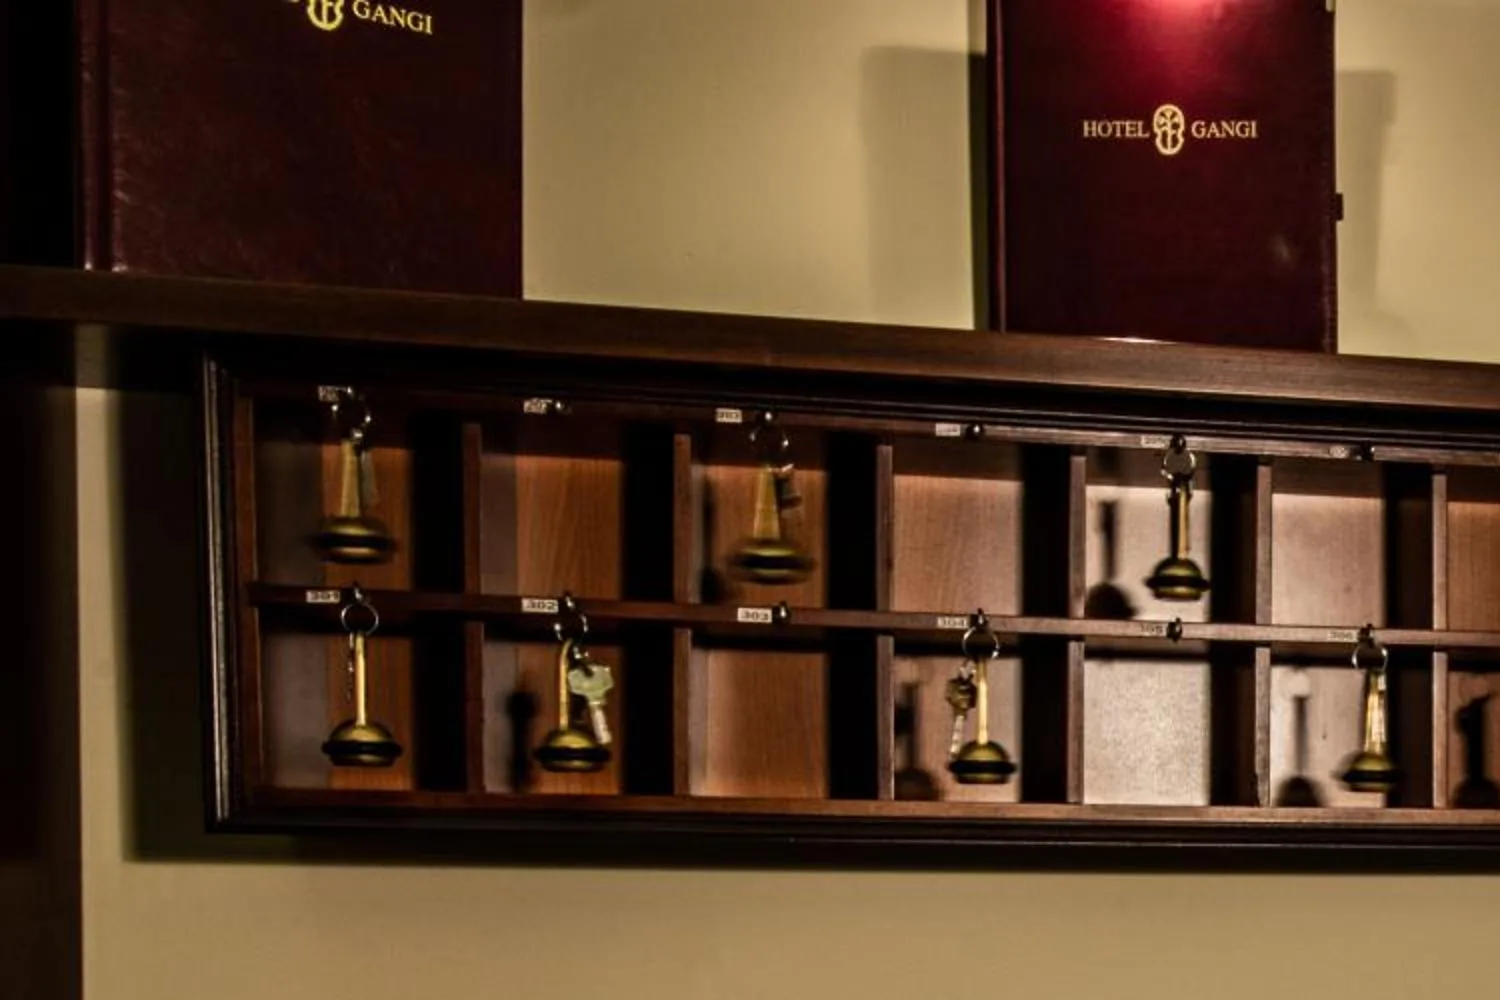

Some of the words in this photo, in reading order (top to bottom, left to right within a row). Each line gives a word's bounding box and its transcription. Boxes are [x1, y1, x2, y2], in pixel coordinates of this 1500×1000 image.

[352, 0, 433, 35] GANGI
[1082, 119, 1150, 138] HOTEL
[1191, 119, 1258, 139] GANGI
